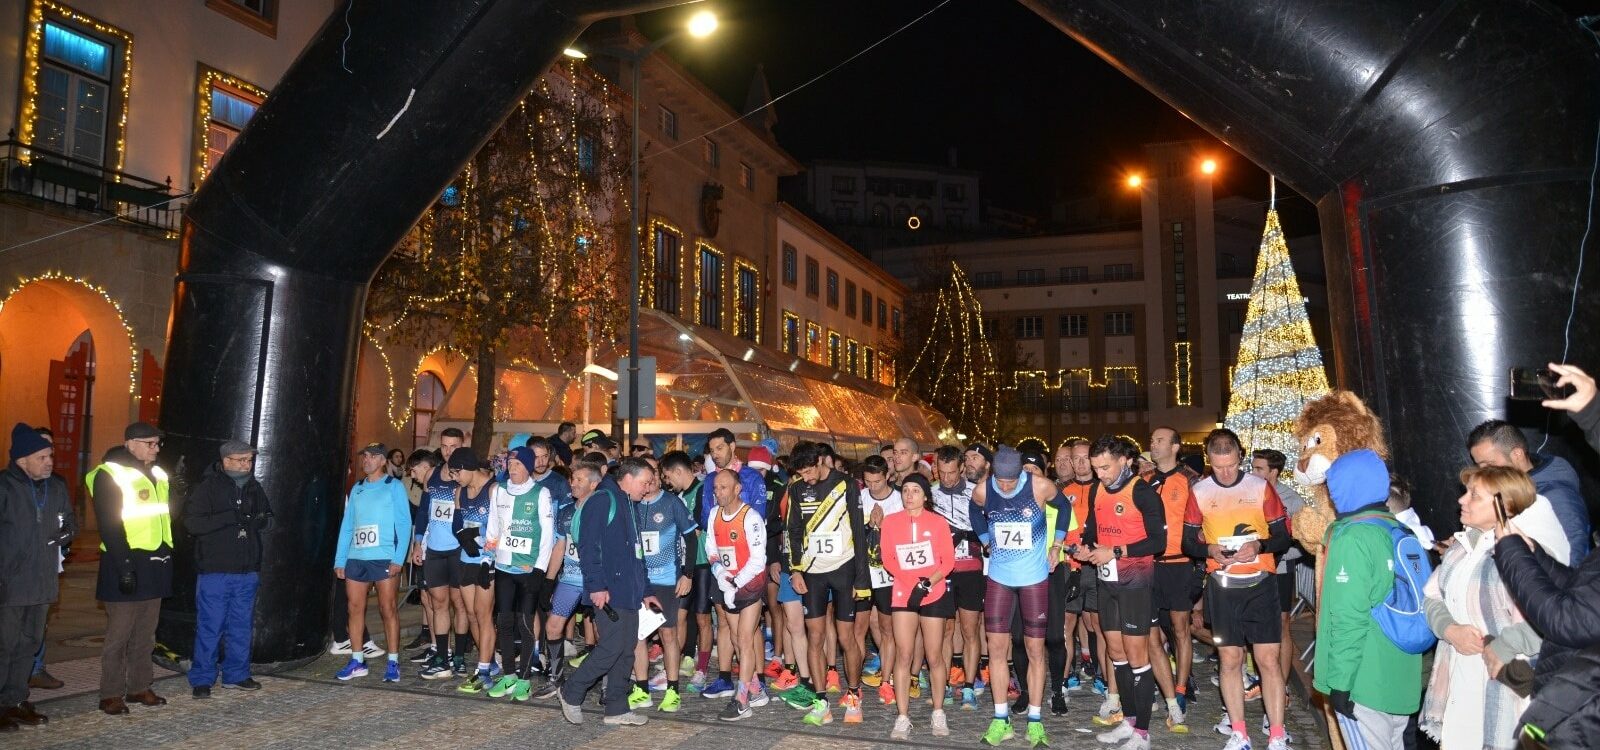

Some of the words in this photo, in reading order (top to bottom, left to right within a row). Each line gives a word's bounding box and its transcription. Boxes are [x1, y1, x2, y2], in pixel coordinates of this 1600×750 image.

[435, 505, 452, 519] 64
[355, 530, 377, 545] 190
[505, 536, 527, 548] 304
[1001, 530, 1024, 546] 74
[816, 538, 834, 554] 15
[905, 549, 927, 566] 43
